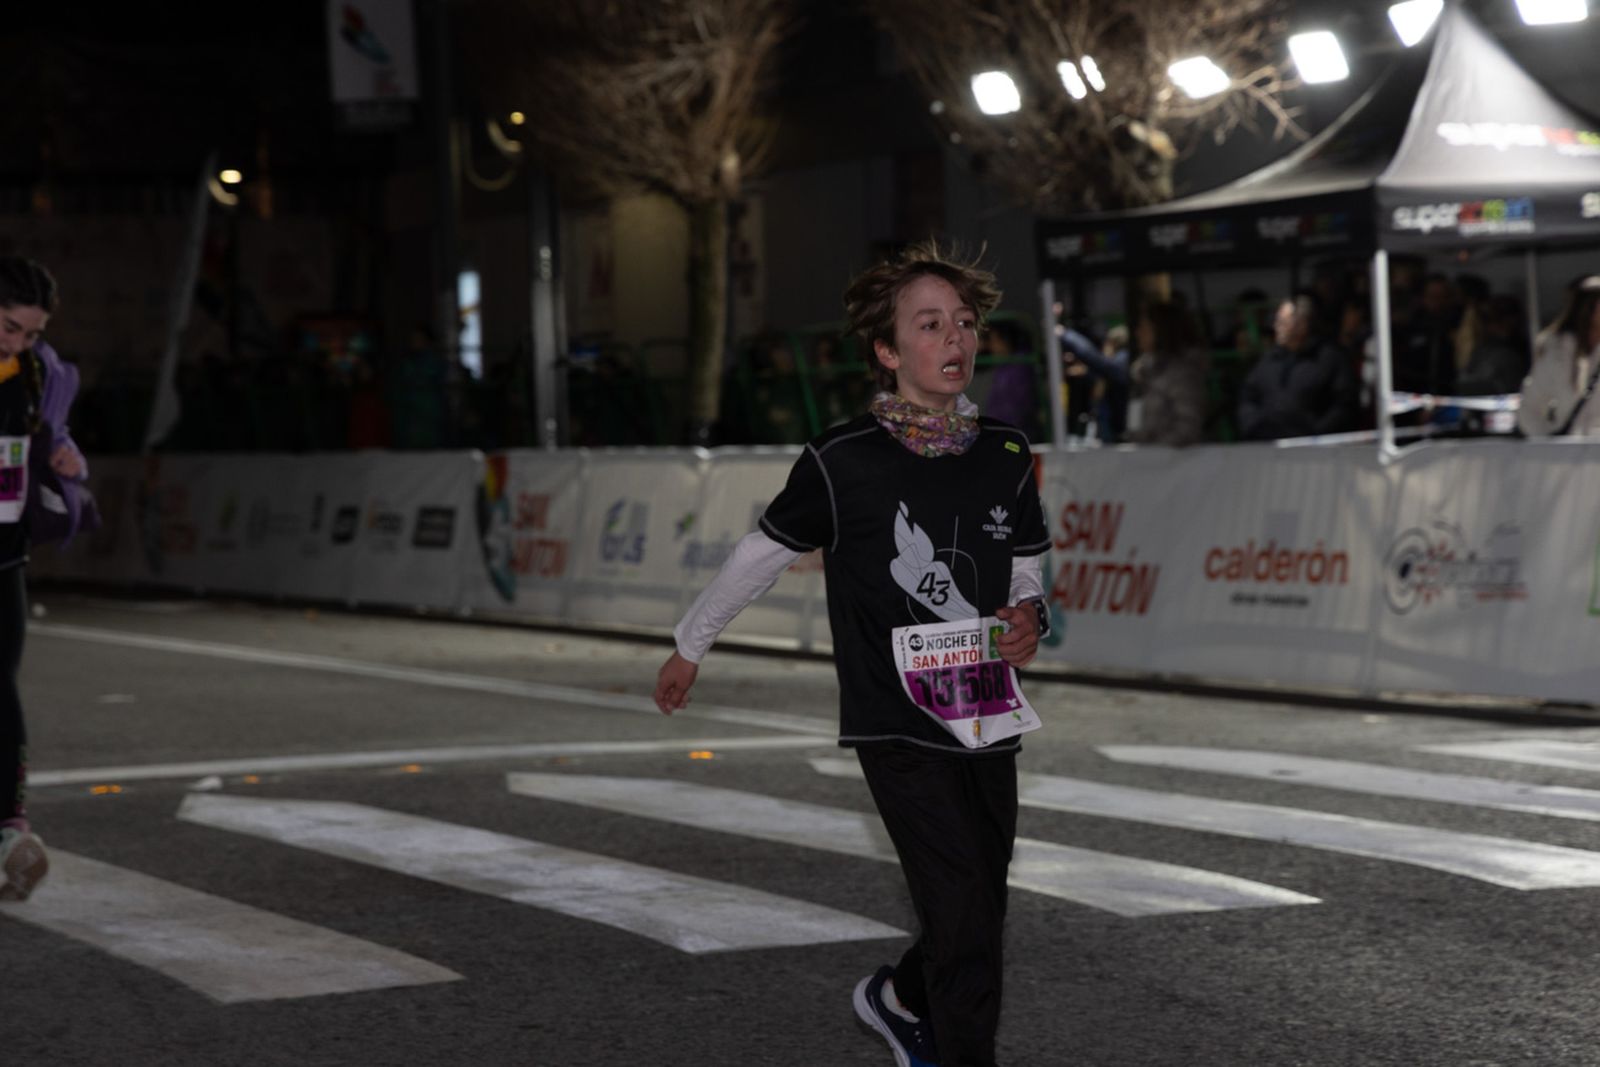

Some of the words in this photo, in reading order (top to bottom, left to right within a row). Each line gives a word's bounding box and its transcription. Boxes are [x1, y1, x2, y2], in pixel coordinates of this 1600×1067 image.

[1054, 500, 1125, 555] SAN
[1049, 546, 1161, 616] ANTÓN
[1204, 538, 1351, 585] calderón
[917, 572, 950, 605] 43
[912, 653, 939, 670] SAN
[926, 635, 967, 652] NOCHE
